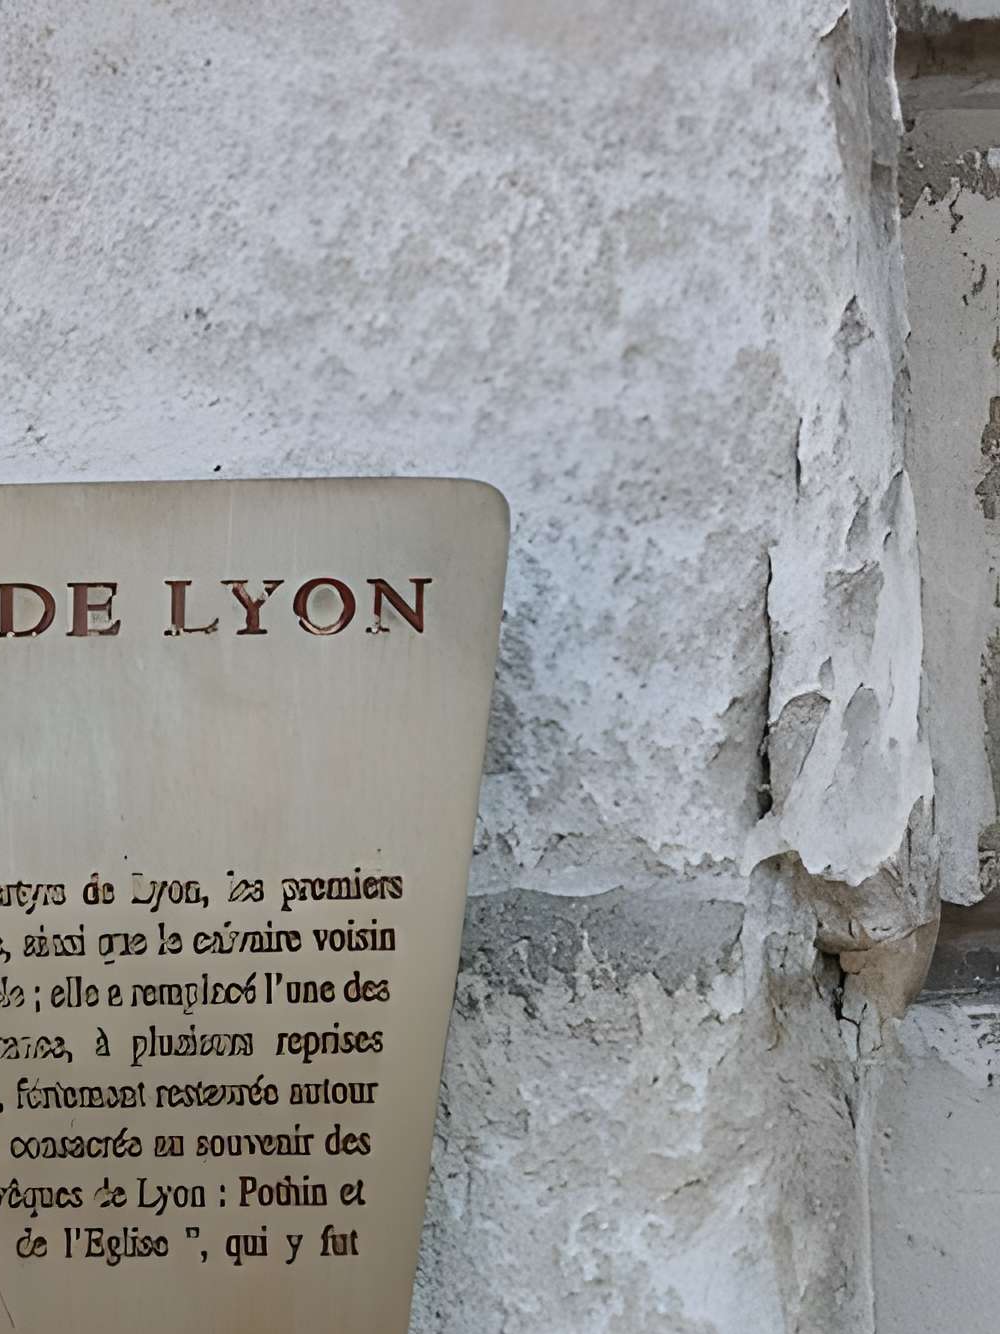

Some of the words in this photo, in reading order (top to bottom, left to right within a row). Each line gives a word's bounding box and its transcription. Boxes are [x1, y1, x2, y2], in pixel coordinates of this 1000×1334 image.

[162, 576, 433, 637] LYON
[81, 871, 116, 906] de
[279, 865, 403, 913] premiers
[156, 920, 183, 956] le
[311, 917, 396, 953] voisin
[49, 974, 100, 1009] elle
[262, 971, 336, 1005] l'une
[342, 969, 391, 1004] des
[94, 1025, 111, 1057] à
[274, 1020, 384, 1065] reprises
[288, 1077, 380, 1106] autour
[152, 1134, 185, 1158] au
[194, 1122, 315, 1158] souvenir
[323, 1122, 372, 1156] des
[135, 1176, 206, 1215] Lyon
[237, 1173, 328, 1208] Pothin
[338, 1177, 367, 1207] et
[14, 1225, 48, 1259] de
[62, 1225, 169, 1266] l'Eglise
[224, 1223, 268, 1266] qui
[284, 1232, 304, 1266] y
[318, 1222, 360, 1257] fut
